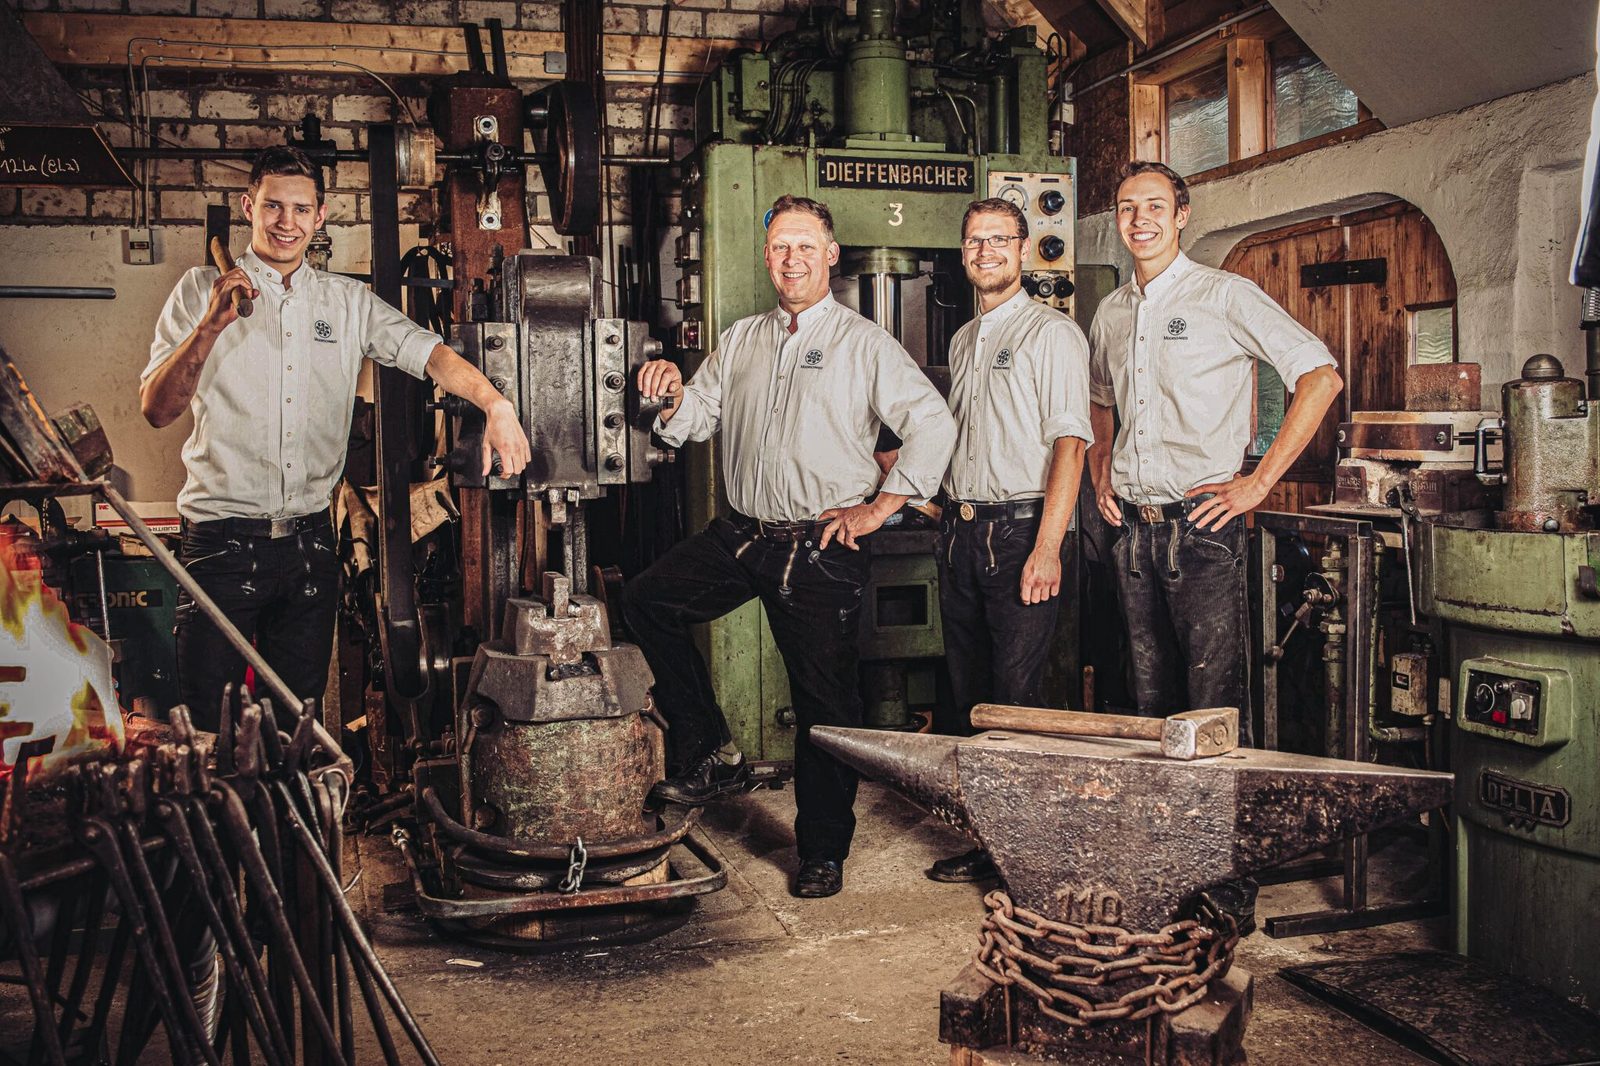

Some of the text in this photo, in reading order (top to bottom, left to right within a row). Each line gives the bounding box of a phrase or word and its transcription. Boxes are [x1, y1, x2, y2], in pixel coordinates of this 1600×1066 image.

[825, 161, 968, 187] DIEFFENBACHER
[887, 202, 904, 227] 3
[1487, 781, 1556, 819] DELTA
[1056, 884, 1122, 925] 110
